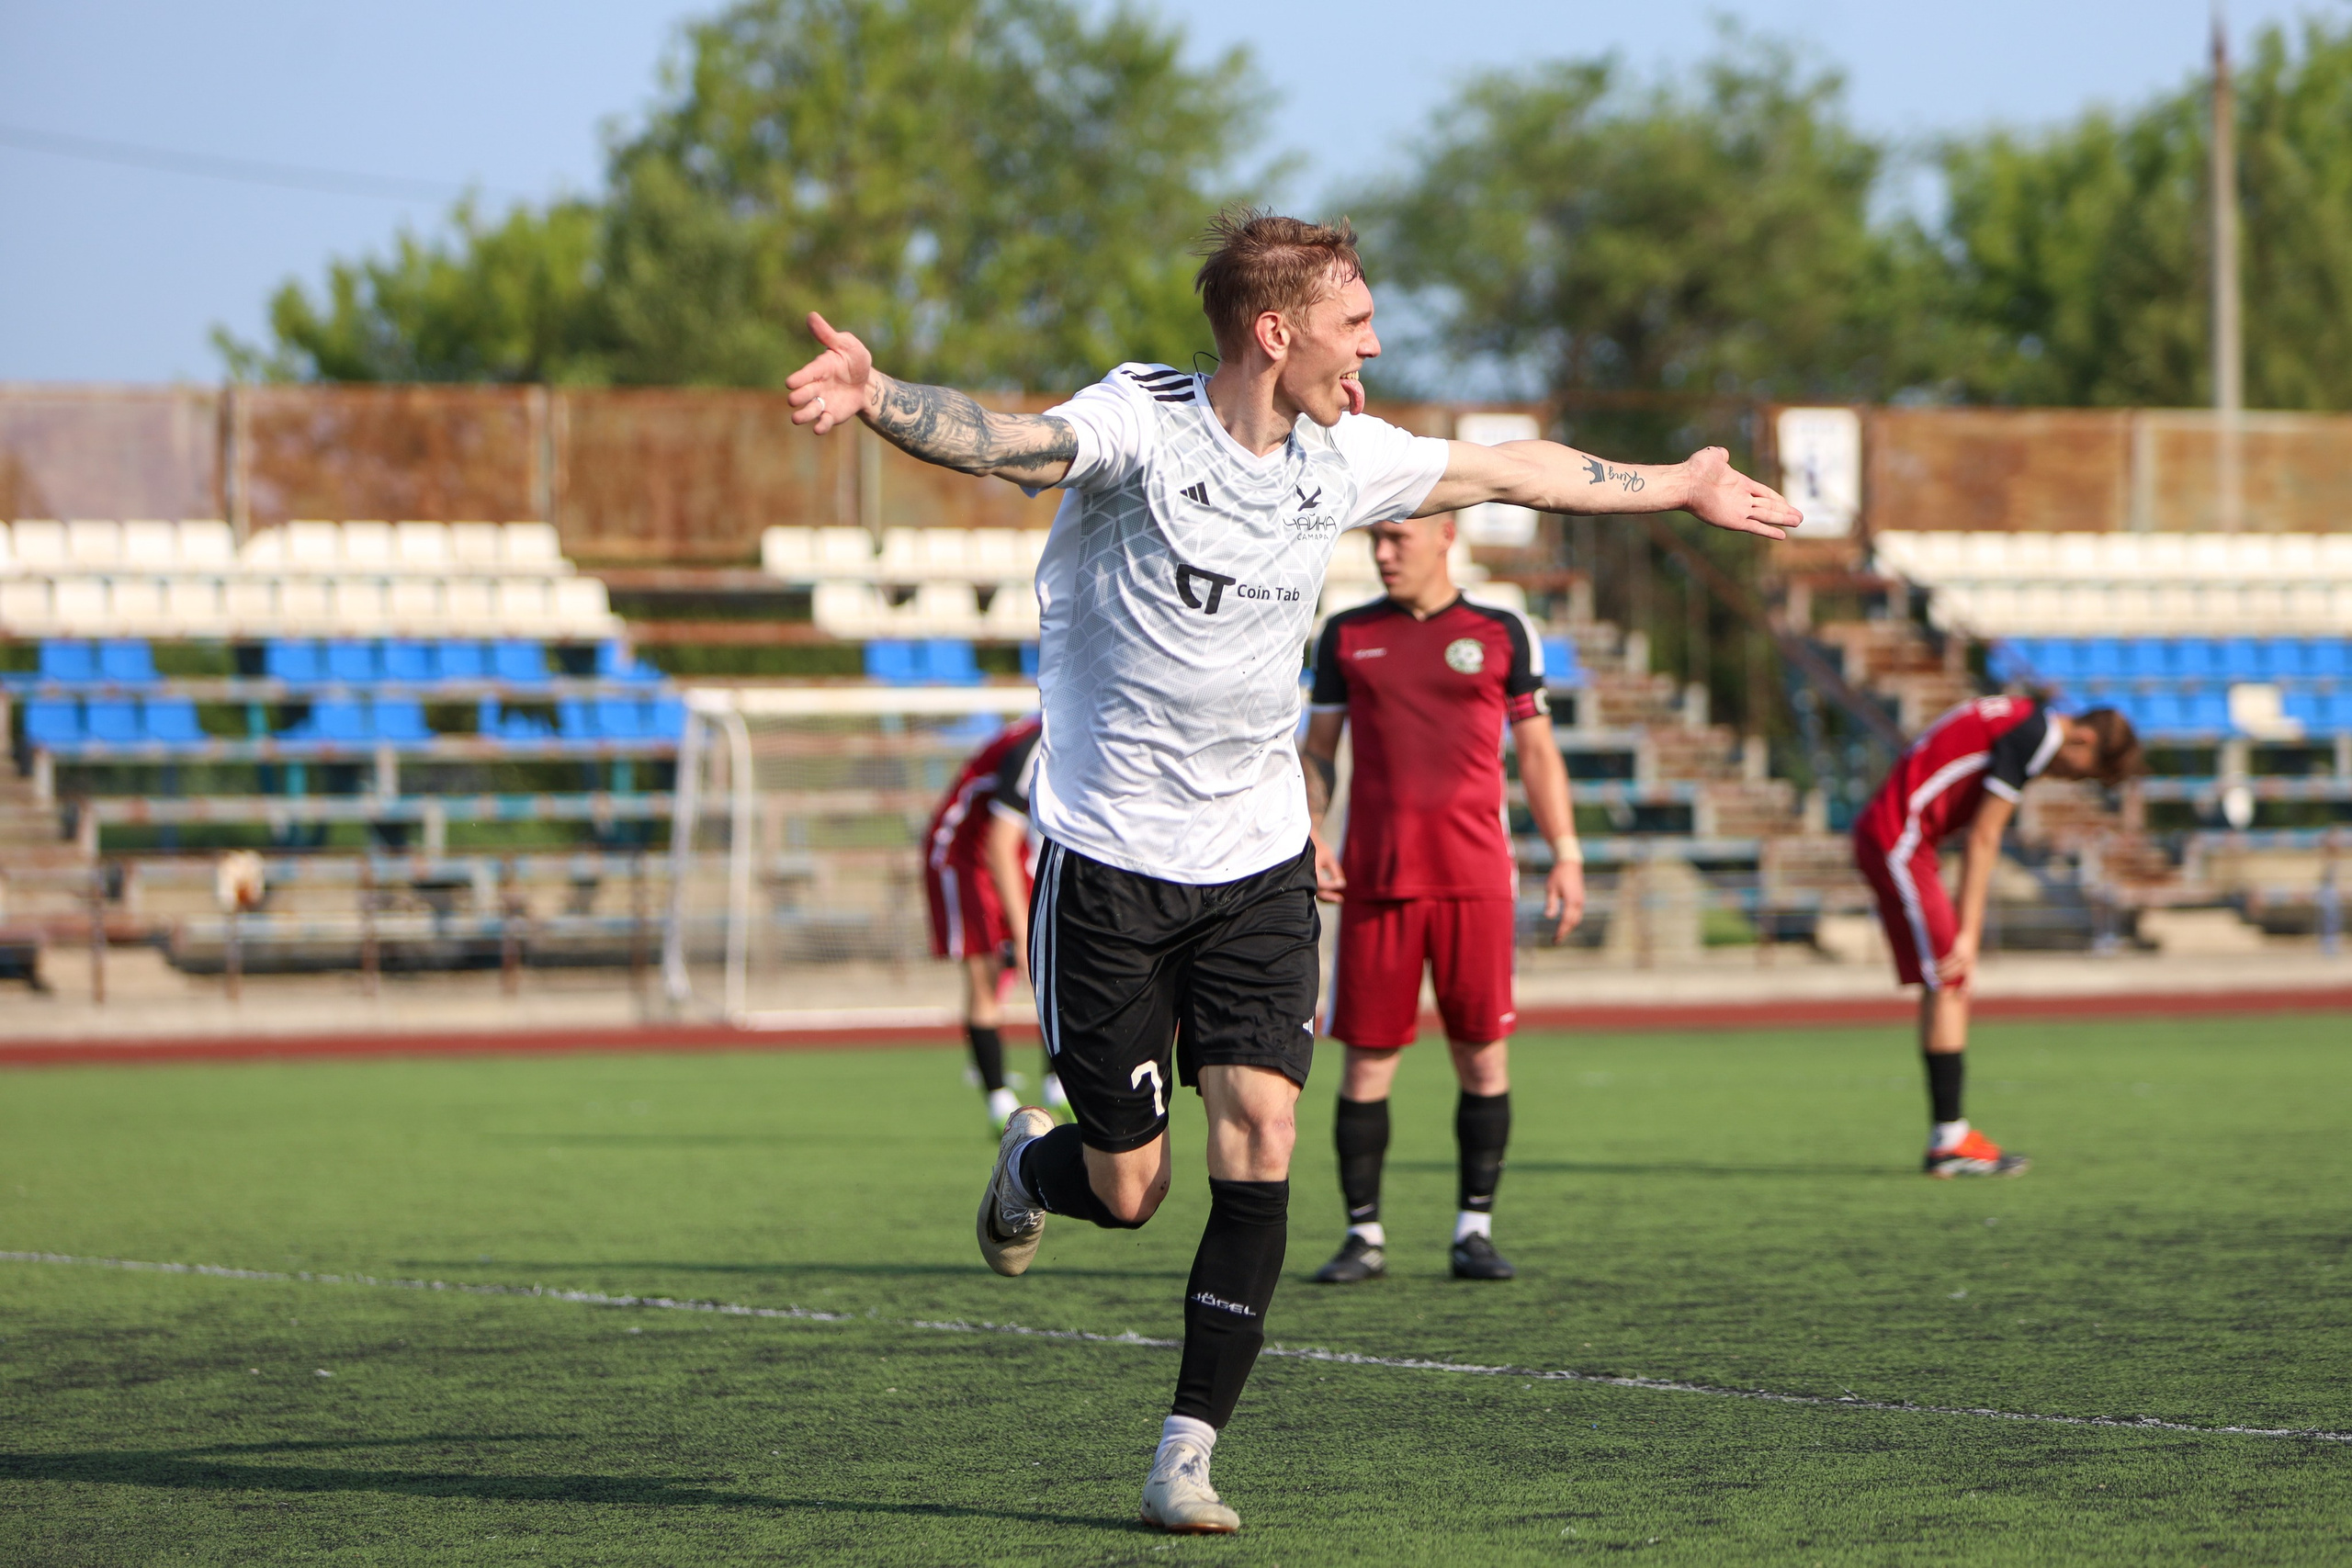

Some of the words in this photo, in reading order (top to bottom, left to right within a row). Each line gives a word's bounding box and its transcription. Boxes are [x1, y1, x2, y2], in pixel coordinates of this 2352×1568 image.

[1608, 466, 1645, 492] King
[1283, 513, 1337, 531] ЧАЙКА
[1296, 533, 1329, 541] САМАРА
[1237, 583, 1271, 600] Coin
[1275, 587, 1300, 602] Tab
[1130, 1059, 1166, 1117] 7
